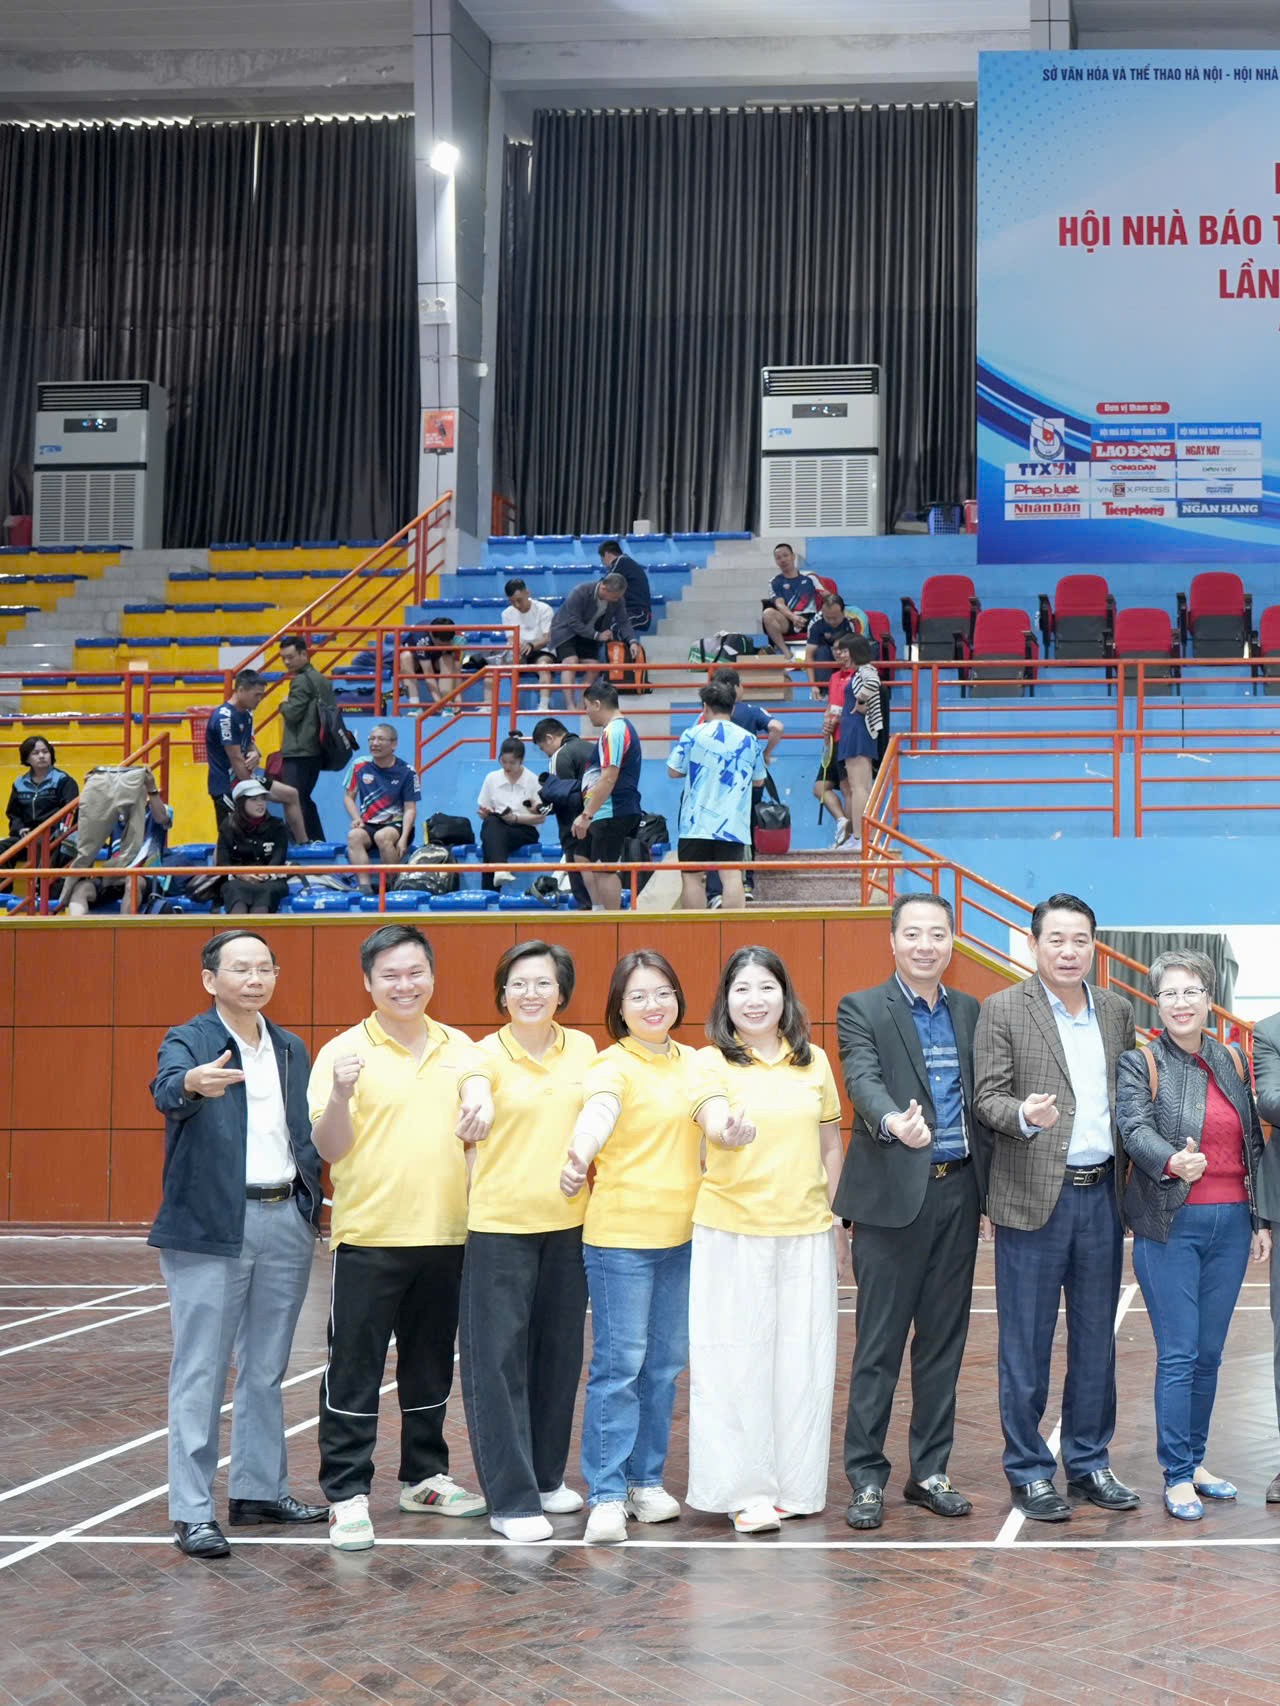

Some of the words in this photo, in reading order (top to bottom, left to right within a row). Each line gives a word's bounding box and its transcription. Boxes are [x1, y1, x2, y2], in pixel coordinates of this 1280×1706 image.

[1042, 65, 1058, 81] SỞ
[1061, 66, 1083, 81] VĂN
[1087, 66, 1109, 81] HÓA
[1112, 66, 1127, 81] VÀ
[1130, 63, 1150, 81] THỂ
[1153, 68, 1181, 81] THAO
[1185, 66, 1200, 81] HÀ
[1203, 66, 1222, 83] NỘI
[1233, 66, 1252, 83] HỘI
[1256, 66, 1279, 81] NHÀ
[1059, 209, 1110, 253] HỘI
[1122, 208, 1188, 246] NHÀ
[1199, 208, 1262, 245] BÁO
[1219, 258, 1280, 299] LẦN
[1096, 445, 1127, 457] LAO
[1206, 445, 1221, 456] NAY
